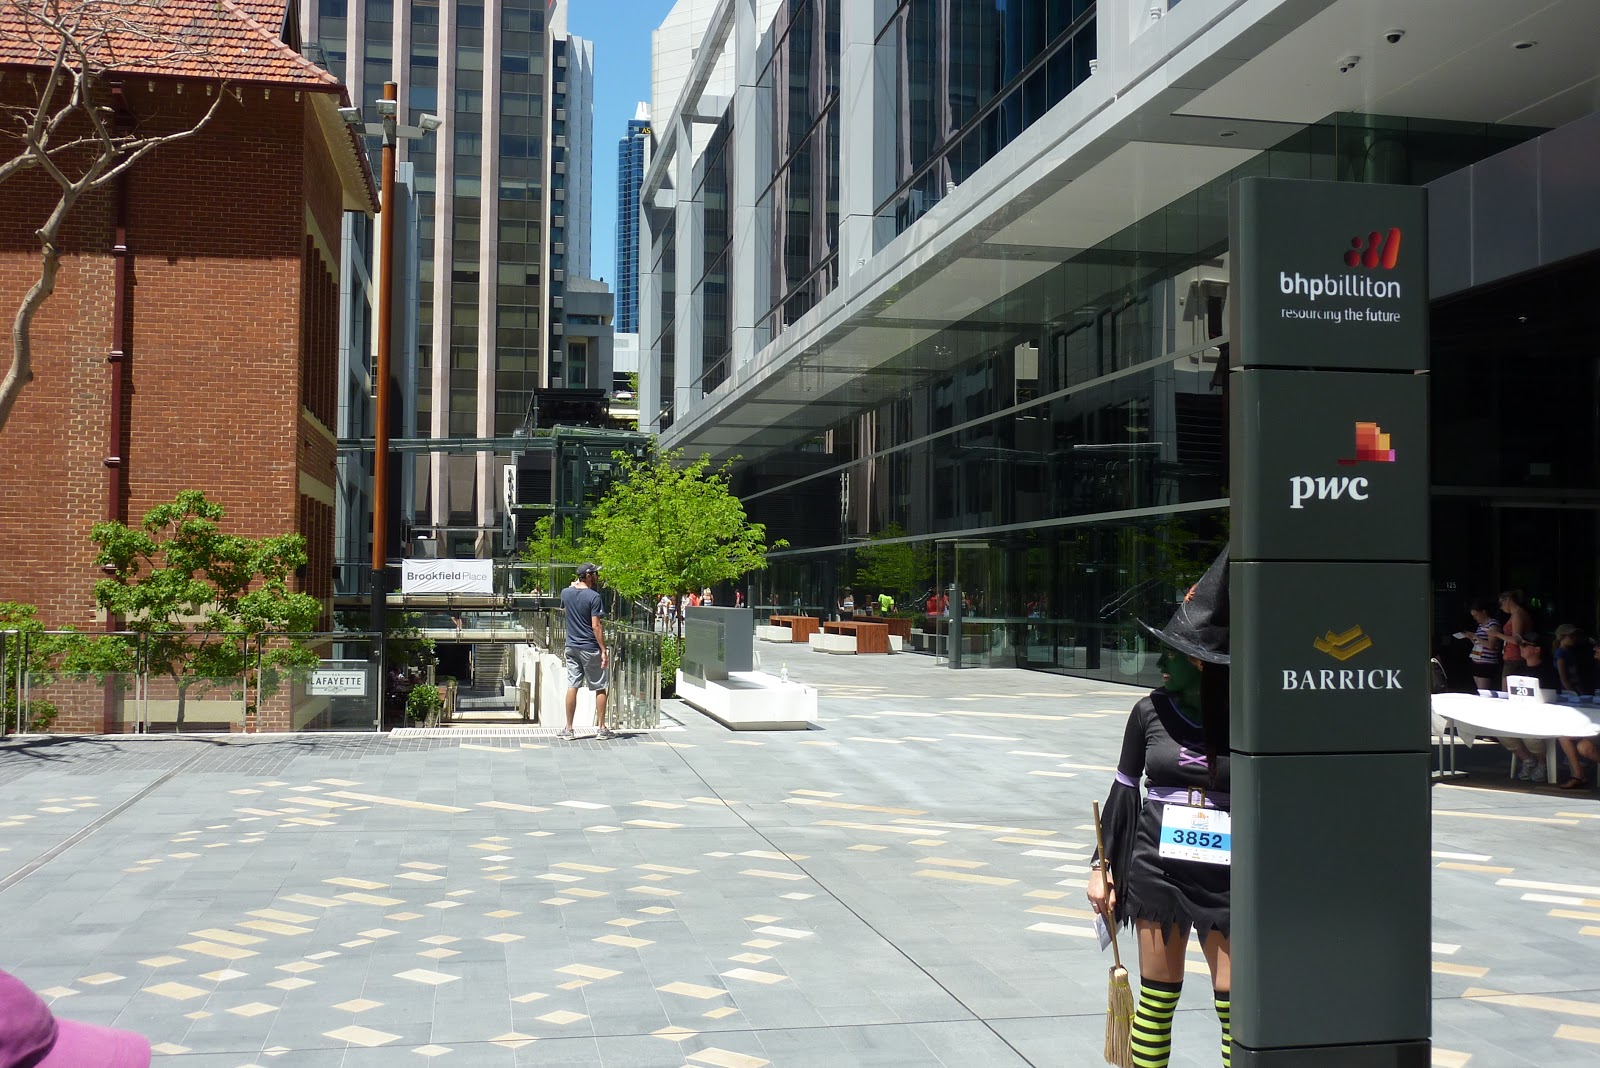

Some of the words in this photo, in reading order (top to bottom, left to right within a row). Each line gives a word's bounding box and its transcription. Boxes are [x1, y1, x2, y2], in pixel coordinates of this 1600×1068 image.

[1280, 271, 1401, 301] bhpbilliton
[1281, 307, 1341, 324] resourcing
[1344, 307, 1364, 321] the
[1365, 307, 1401, 323] future
[1289, 475, 1369, 509] pwc
[407, 571, 461, 581] Brookfield
[462, 571, 487, 581] Place
[310, 677, 362, 685] LAFAYETTE
[1282, 669, 1403, 690] BARRICK
[1516, 687, 1528, 696] 20
[1172, 829, 1222, 849] 3852
